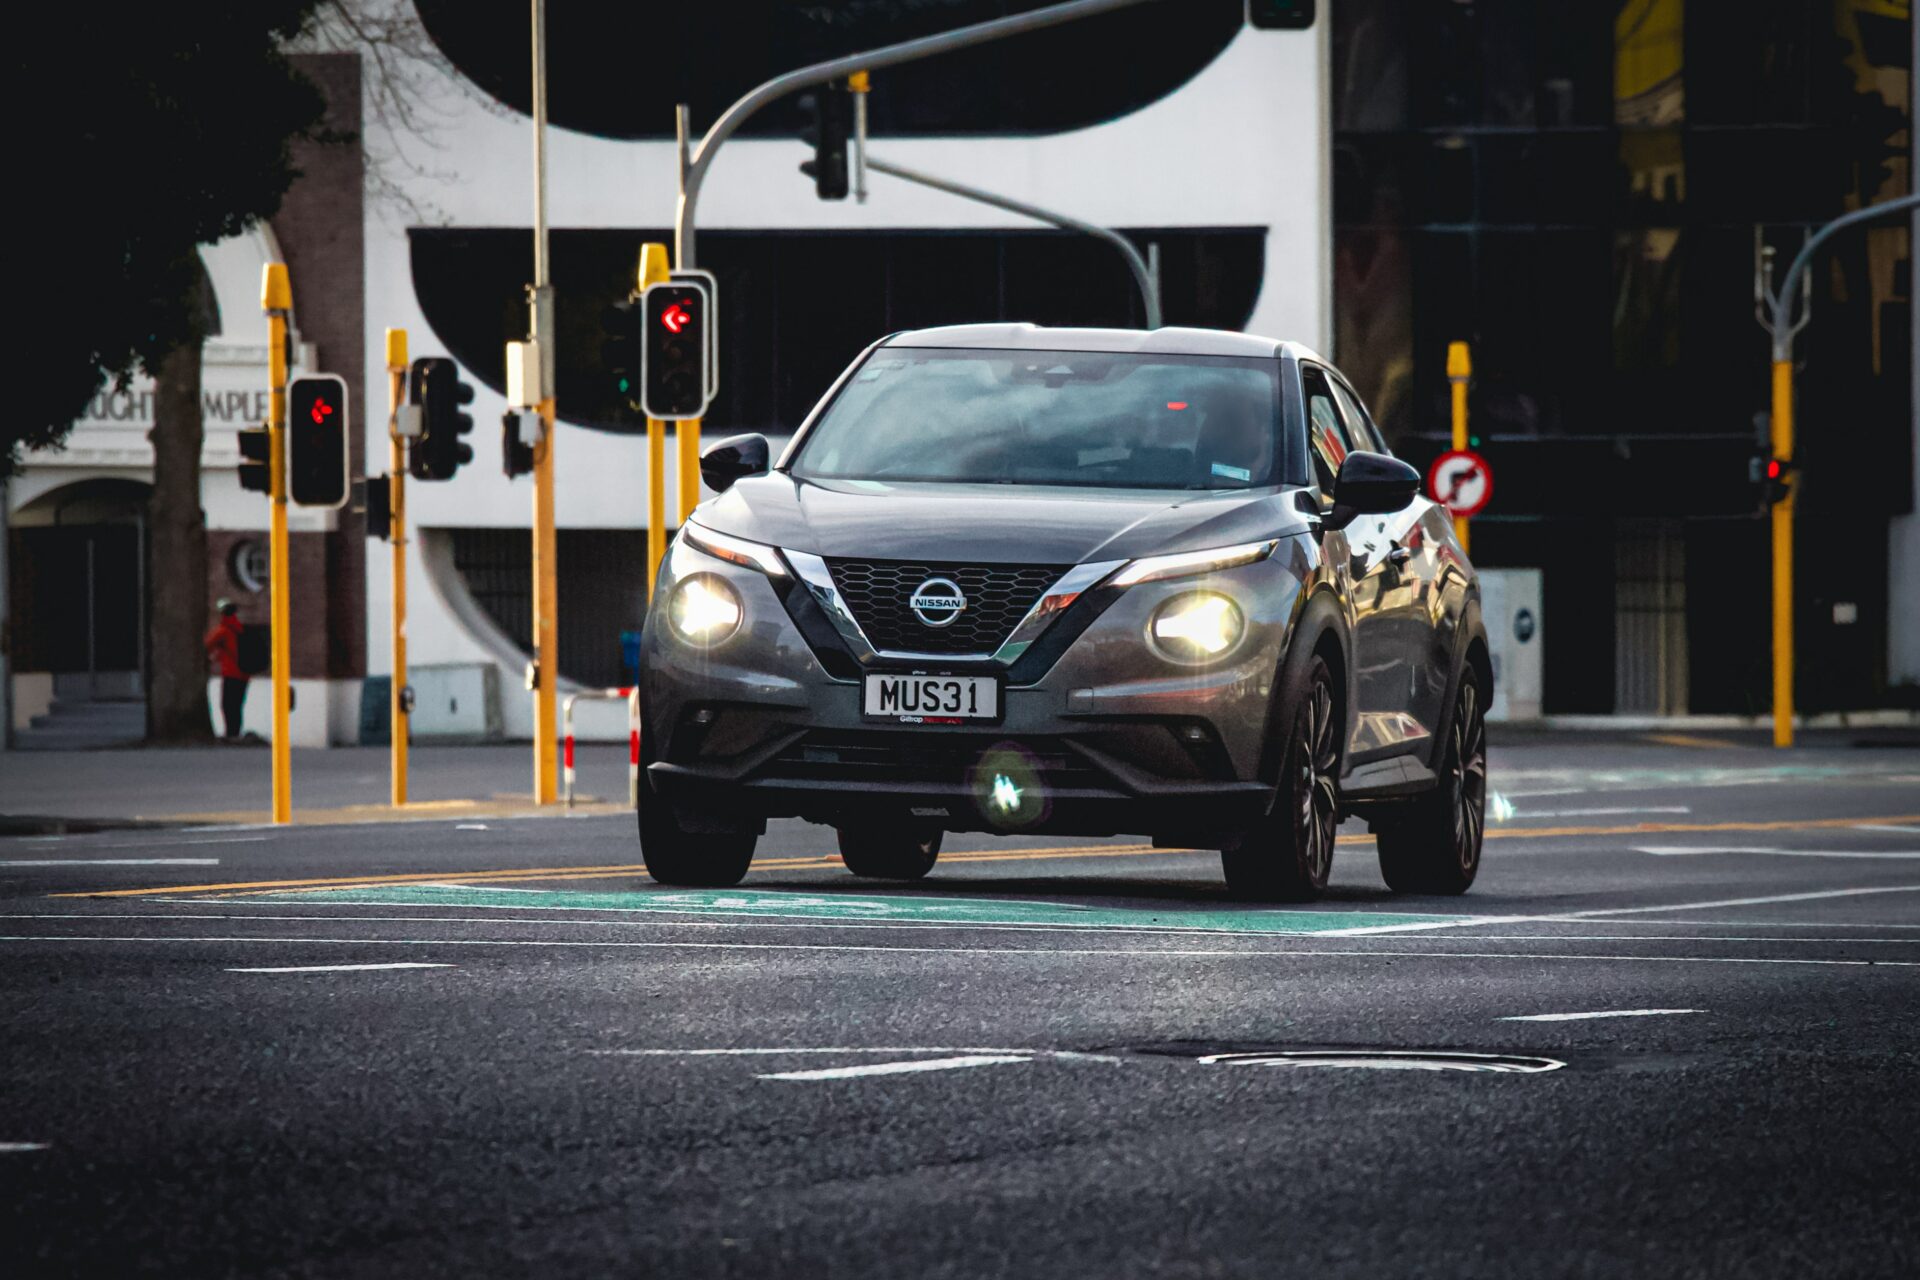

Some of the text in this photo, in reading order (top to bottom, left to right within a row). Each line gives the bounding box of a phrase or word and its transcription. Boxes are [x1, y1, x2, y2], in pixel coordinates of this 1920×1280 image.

[88, 390, 269, 421] UGHT MPLE
[914, 598, 961, 608] NISSAN
[879, 679, 977, 713] MUS31
